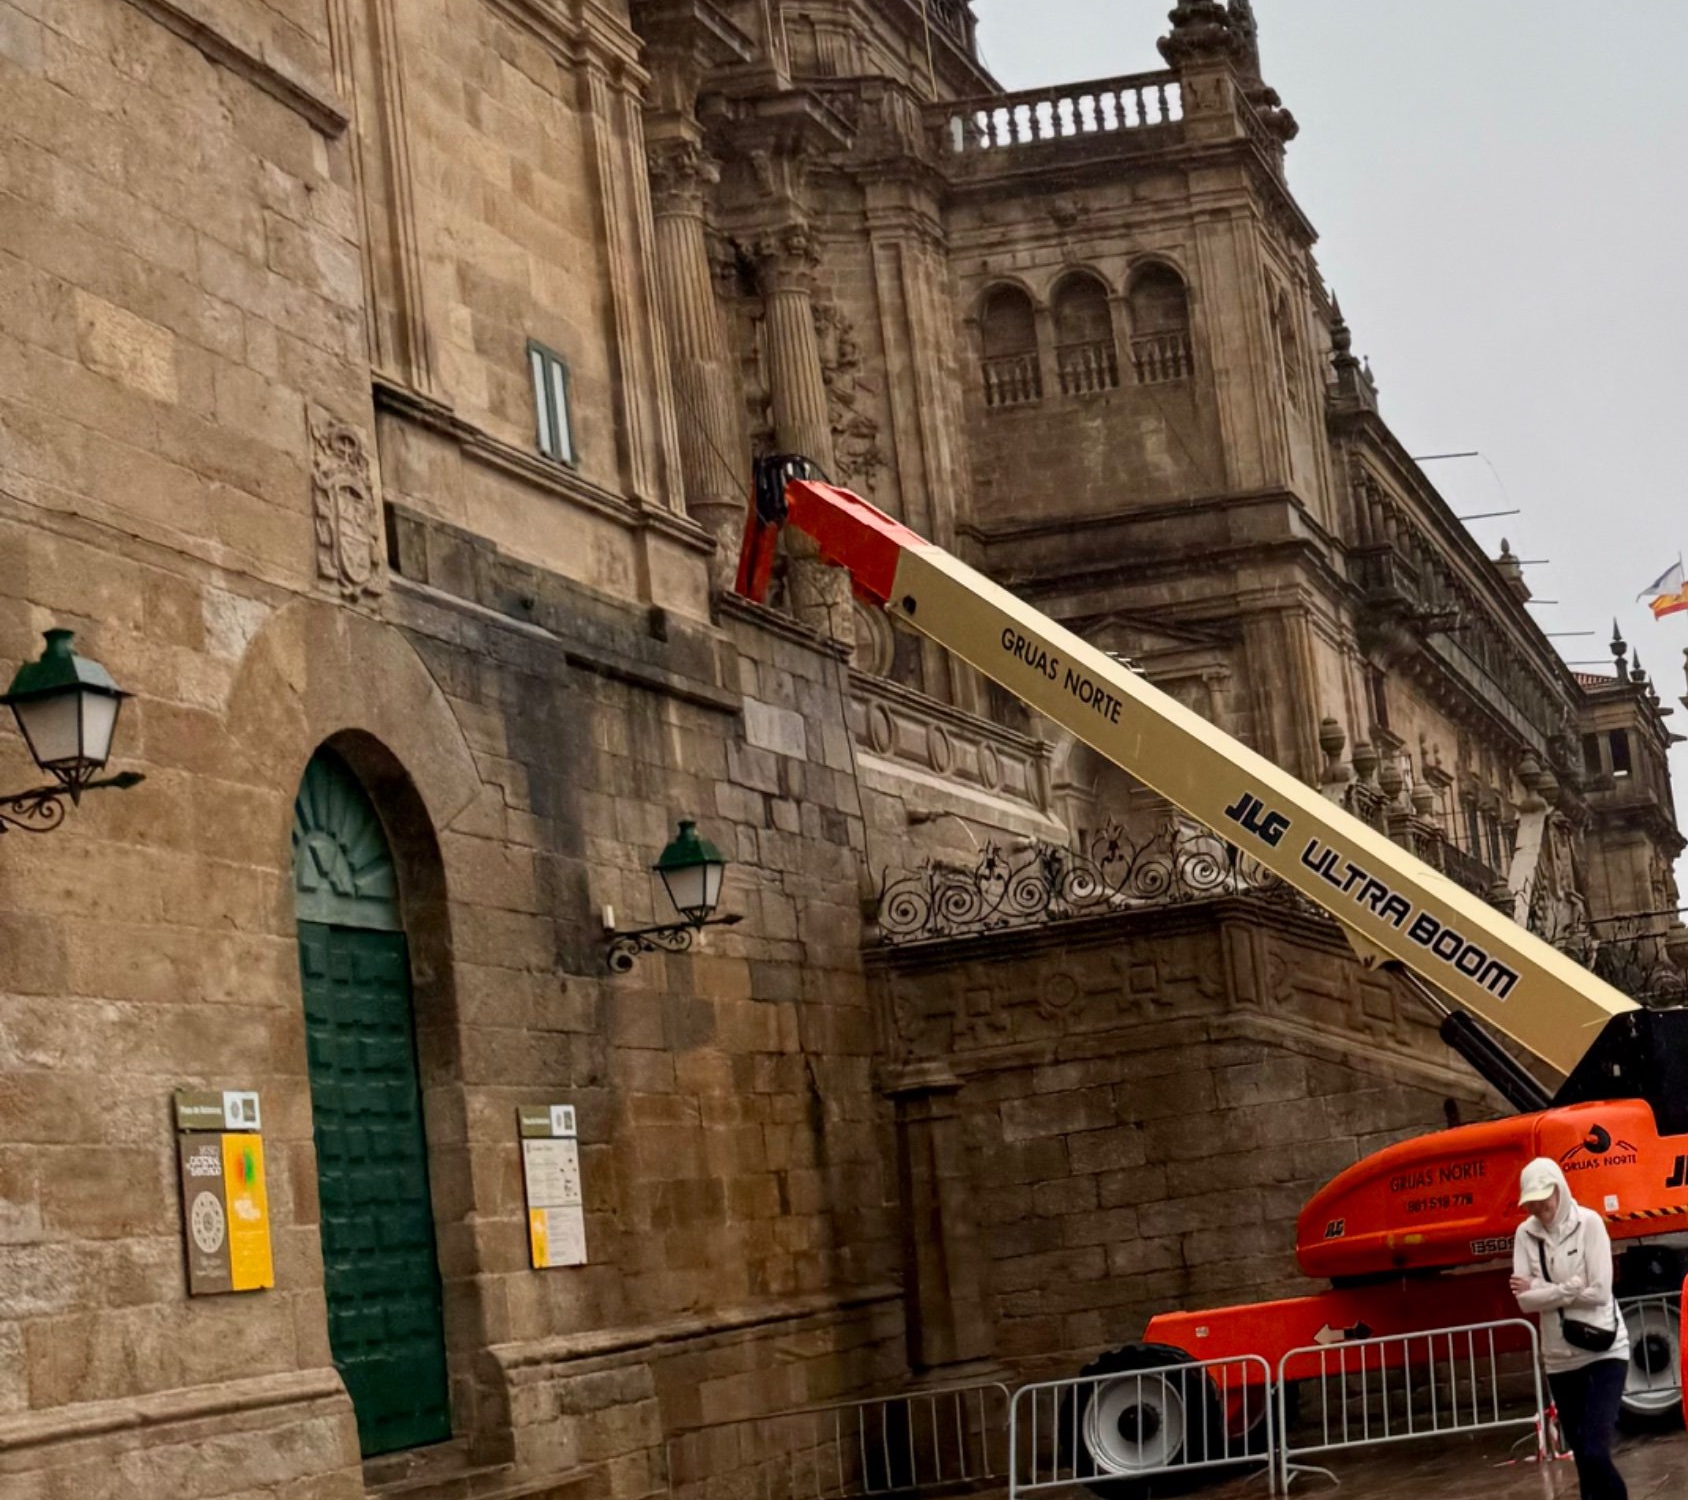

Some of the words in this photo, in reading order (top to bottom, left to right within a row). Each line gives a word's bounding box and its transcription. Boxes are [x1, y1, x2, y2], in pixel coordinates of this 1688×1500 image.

[1001, 628, 1059, 680] GRUAS
[1064, 668, 1122, 724] NORTE
[1224, 792, 1291, 848] JLG
[1301, 839, 1412, 928] ULTRA
[1407, 912, 1519, 1000] BOOM
[1391, 1172, 1434, 1193] GRUAS
[1439, 1158, 1486, 1183] NORTE
[1563, 1160, 1600, 1173] GRUAS
[1603, 1154, 1637, 1167] NORTE
